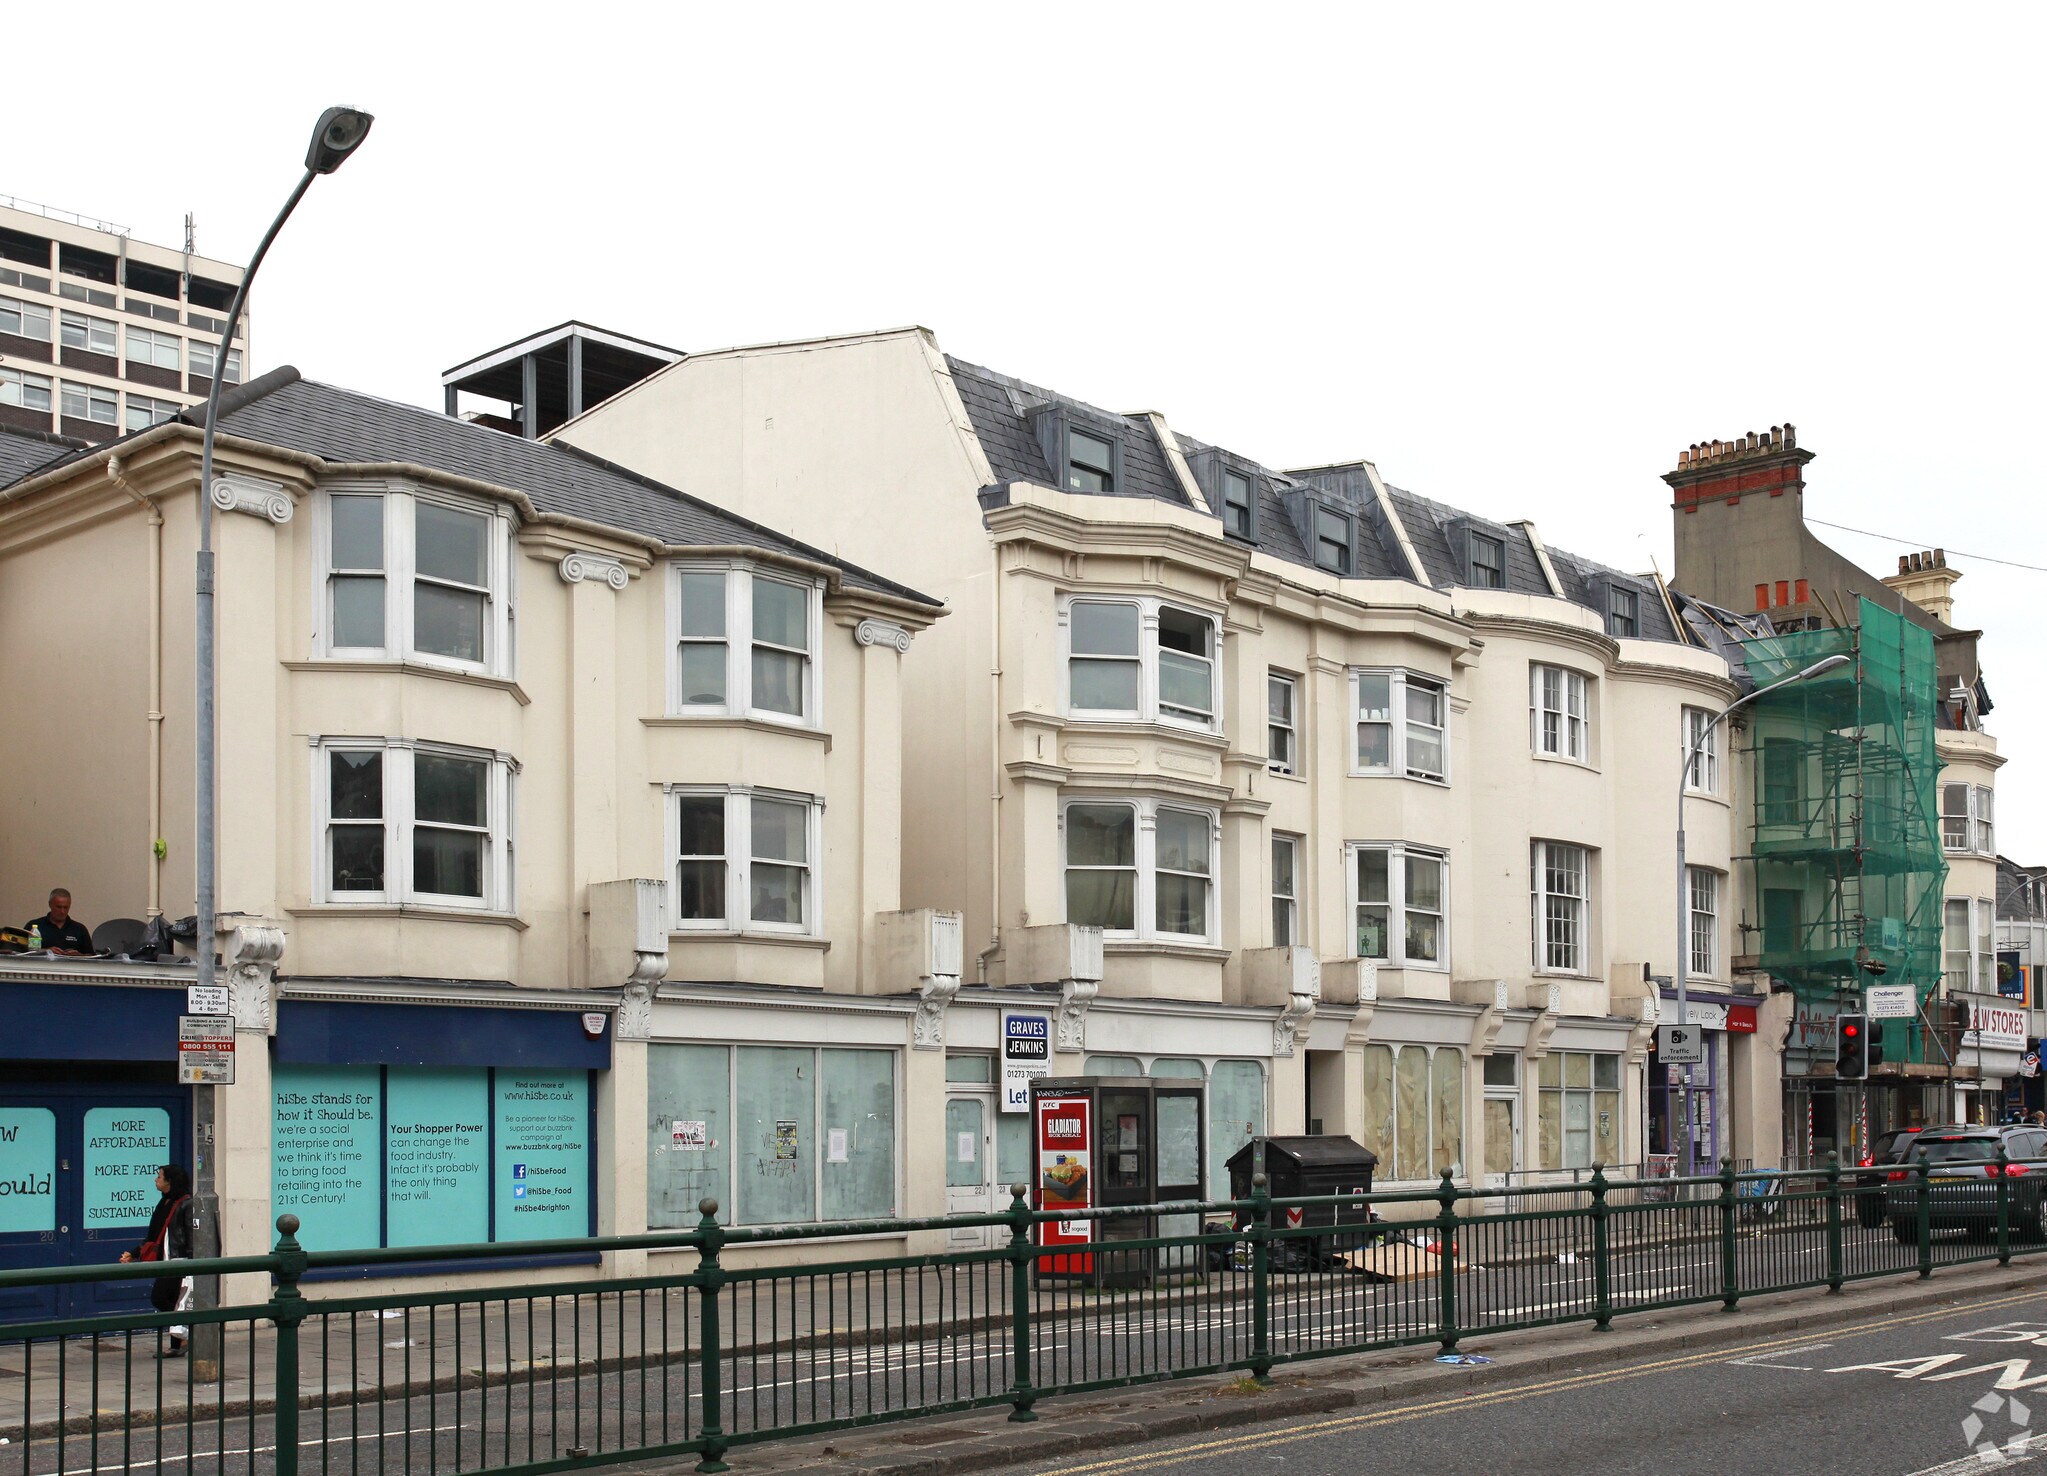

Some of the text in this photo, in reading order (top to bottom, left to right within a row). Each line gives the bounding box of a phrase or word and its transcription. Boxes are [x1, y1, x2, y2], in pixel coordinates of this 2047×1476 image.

[1701, 1010, 1716, 1019] Look
[1010, 1021, 1044, 1034] GRAVES
[1982, 1009, 1990, 1031] W
[1992, 1010, 2024, 1035] STORES
[1009, 1041, 1044, 1053] JENKINS
[277, 1093, 373, 1104] hiSbe stands for
[1009, 1088, 1027, 1104] Let
[277, 1108, 373, 1120] how it Should be.
[112, 1121, 145, 1132] MORE
[277, 1125, 306, 1134] we're
[320, 1124, 350, 1133] social
[390, 1124, 483, 1135] Your Shopper Power
[1048, 1119, 1081, 1133] GLADIATOR
[89, 1136, 166, 1148] AFFORDABLE
[278, 1138, 353, 1149] enterprise and
[413, 1138, 451, 1148] change
[454, 1137, 470, 1145] the
[297, 1152, 321, 1162] think
[324, 1152, 336, 1161] it's
[340, 1152, 362, 1161] time
[391, 1150, 456, 1160] food industry.
[95, 1165, 159, 1176] MORE FAIR
[278, 1166, 346, 1177] to bring food
[390, 1163, 479, 1174] Infact it's probably
[278, 1179, 362, 1191] retailing into the
[391, 1177, 456, 1188] the only thing
[111, 1190, 144, 1201] MORE
[278, 1193, 346, 1205] 21st Century!
[391, 1191, 431, 1201] that will.
[88, 1230, 98, 1240] 21
